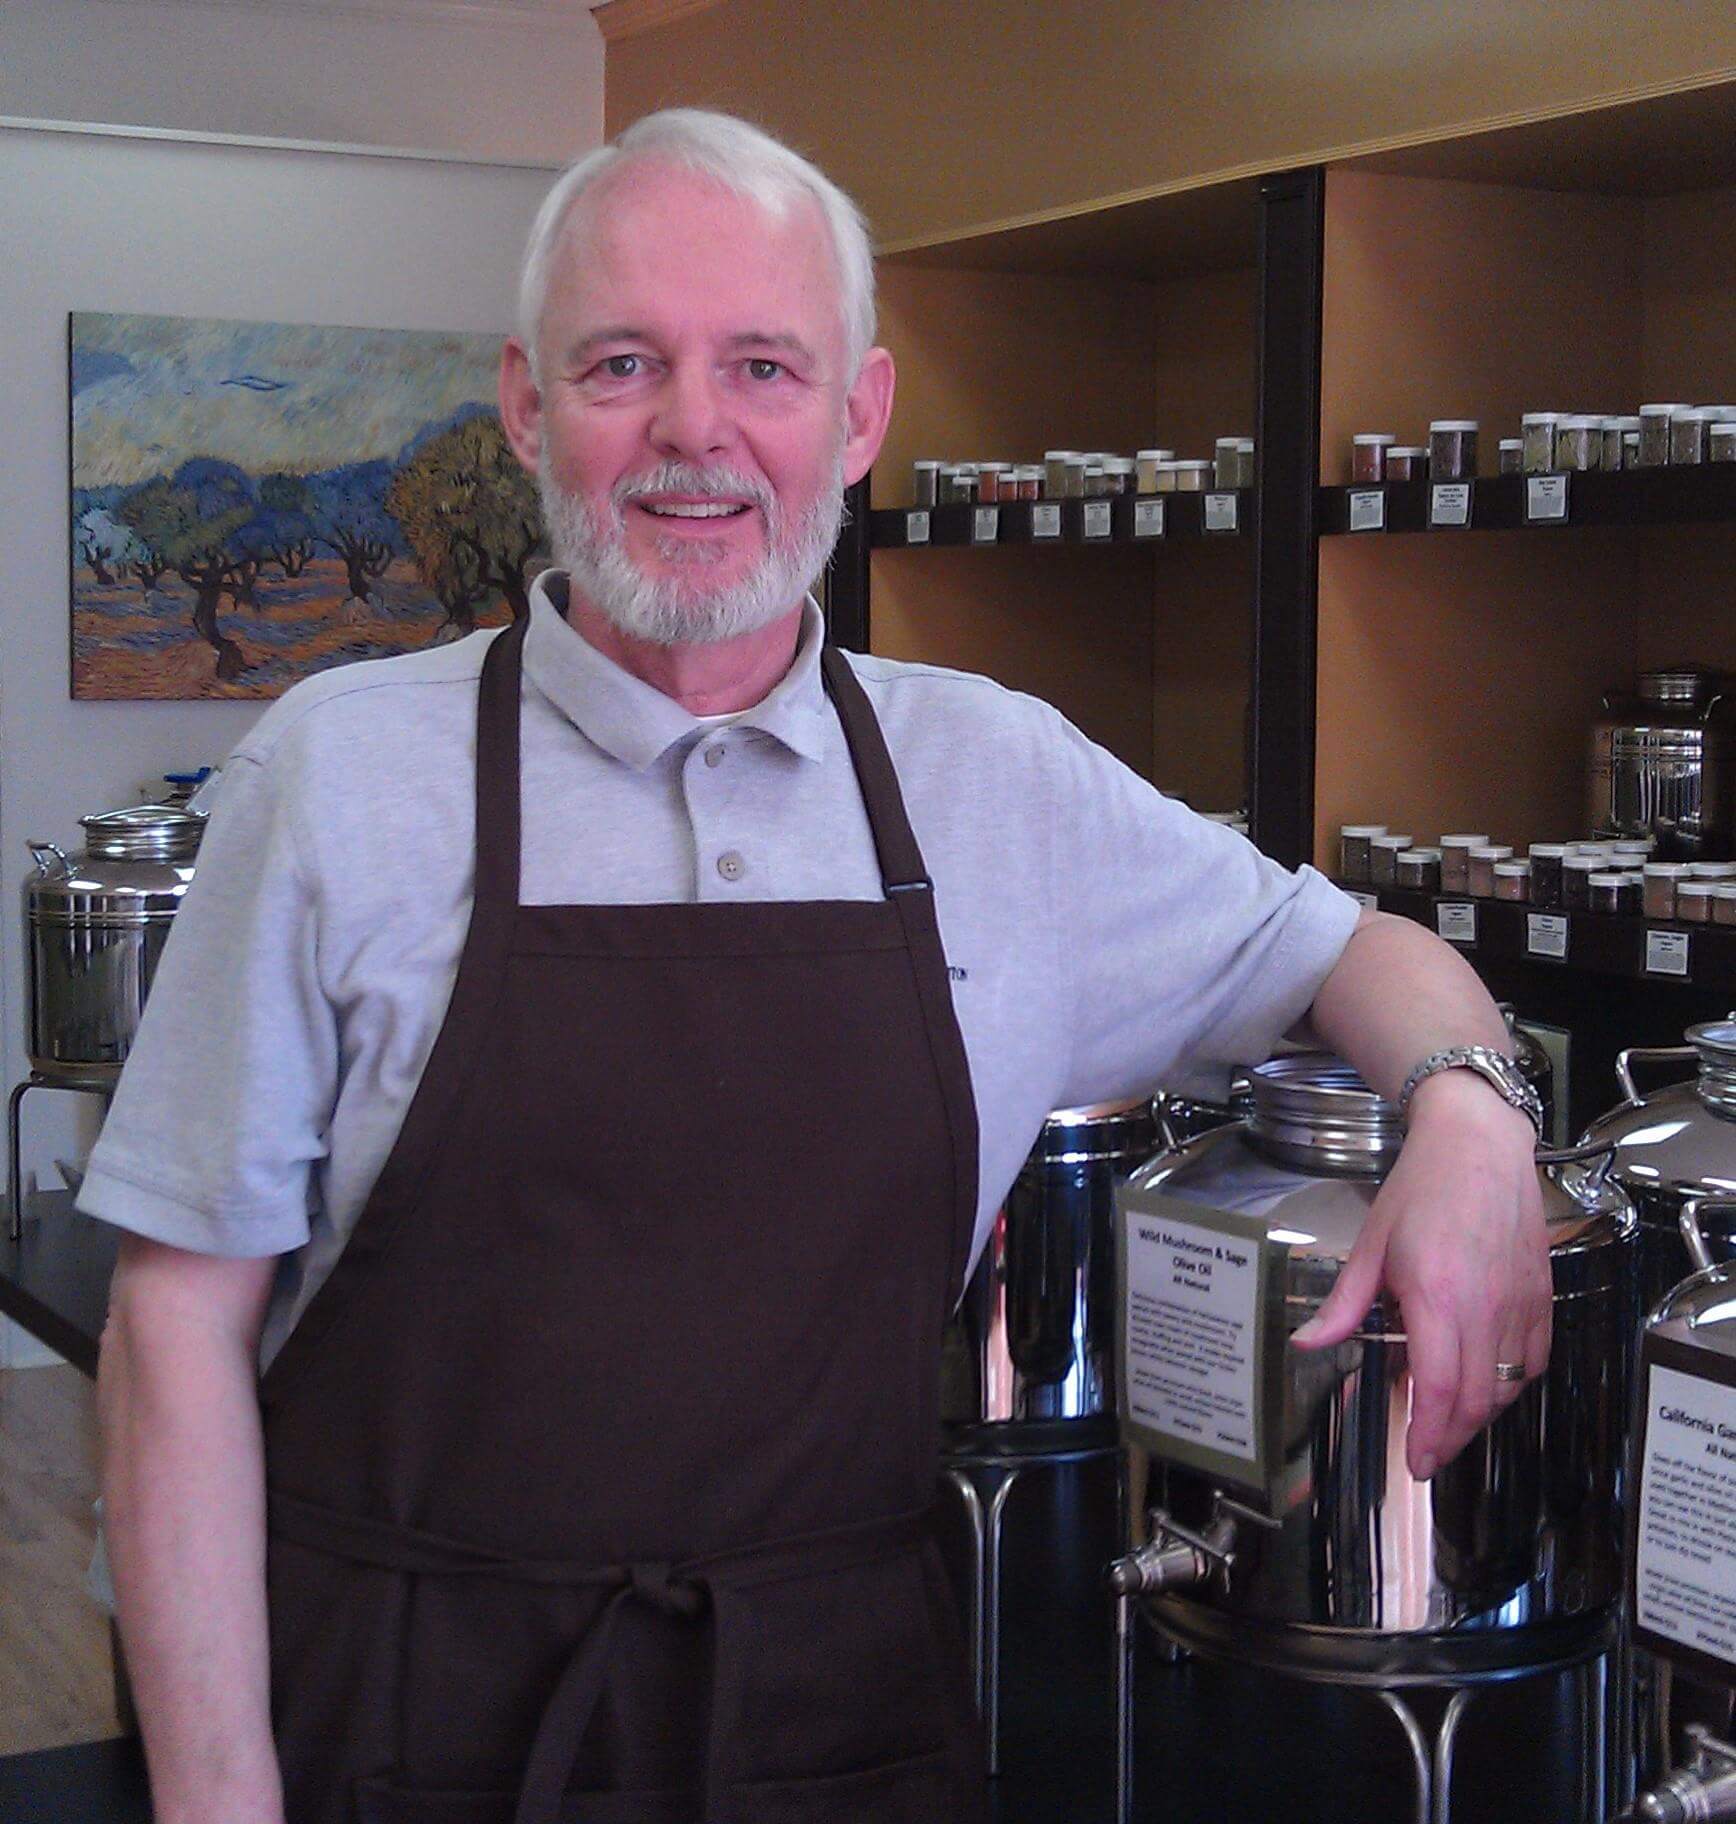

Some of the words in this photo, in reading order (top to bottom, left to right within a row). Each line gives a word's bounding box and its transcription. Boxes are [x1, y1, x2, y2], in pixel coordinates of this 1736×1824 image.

[1138, 1226, 1160, 1243] Wild
[1162, 1233, 1213, 1257] Mushroom
[1215, 1246, 1223, 1259] &
[1225, 1249, 1248, 1268] Sage
[1172, 1256, 1196, 1273] Olive
[1198, 1263, 1212, 1276] Oil
[1659, 1405, 1715, 1435] California
